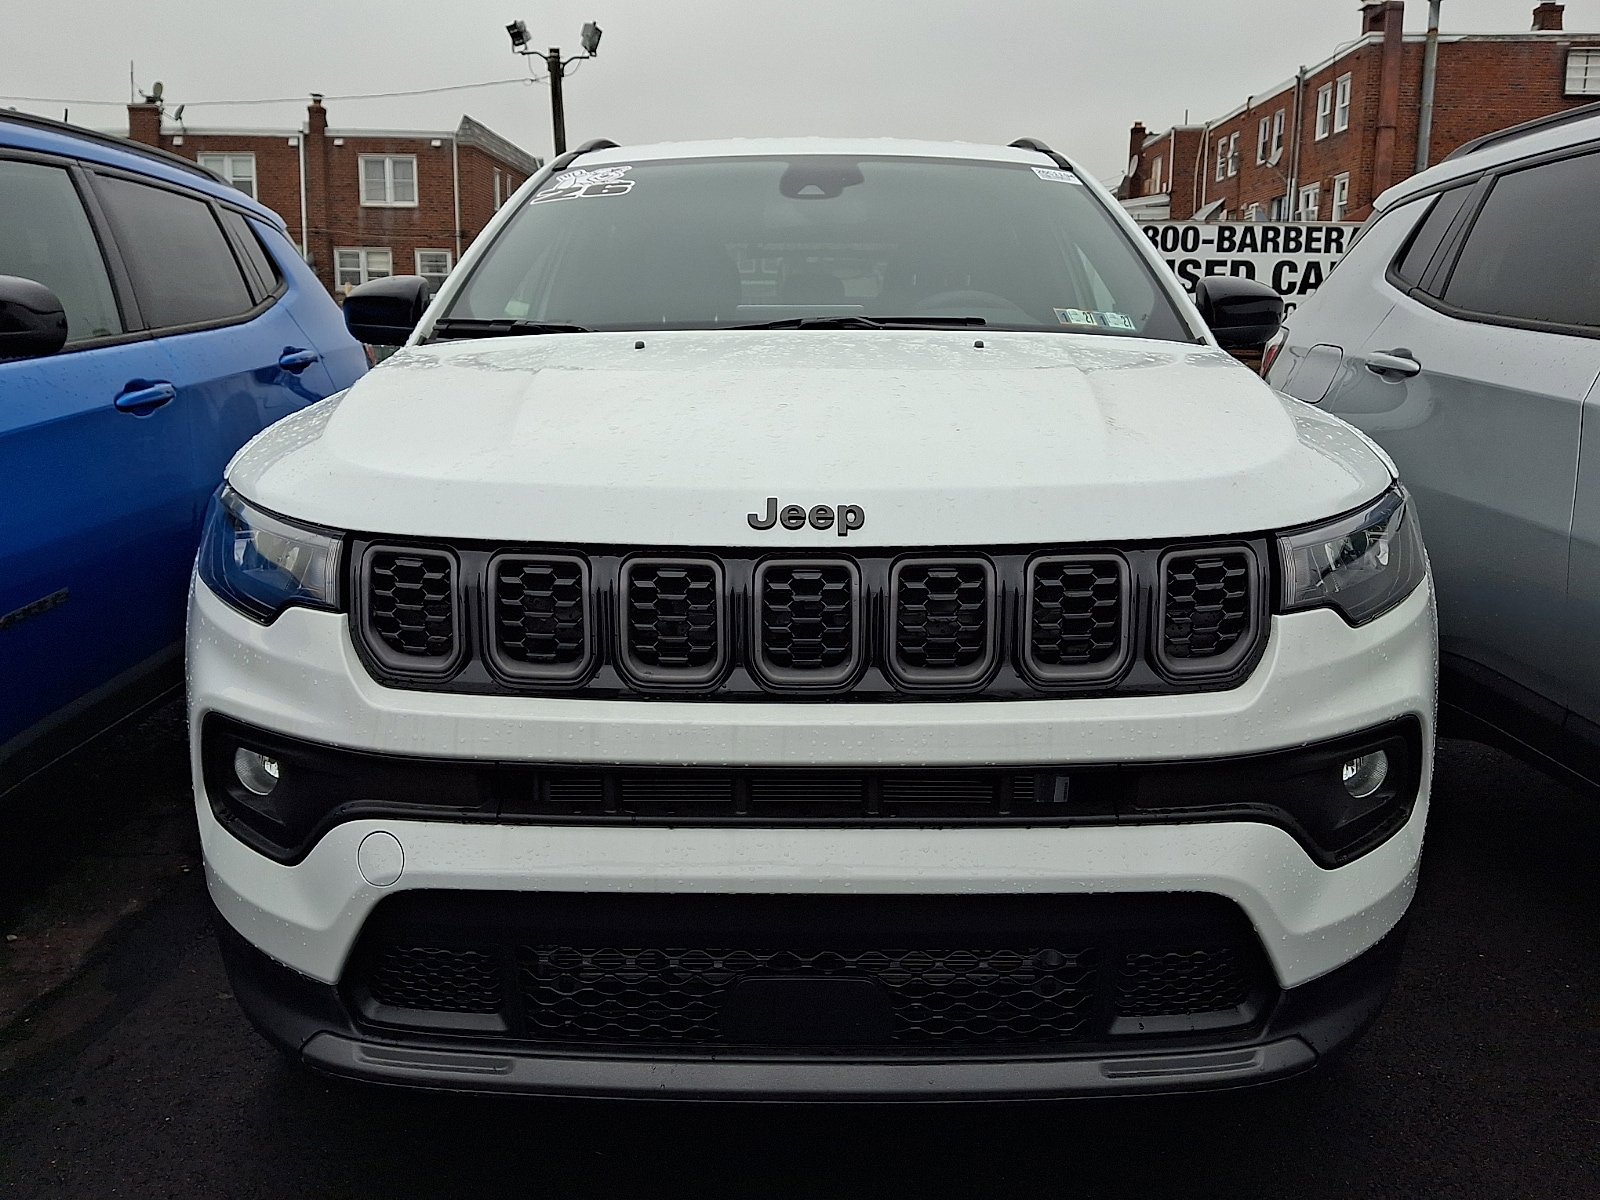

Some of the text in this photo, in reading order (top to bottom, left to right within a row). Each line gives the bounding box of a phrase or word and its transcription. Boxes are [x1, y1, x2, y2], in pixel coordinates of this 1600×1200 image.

[1142, 225, 1361, 253] 800-BARBER
[1165, 258, 1337, 296] SED CA
[747, 497, 865, 537] Jeep
